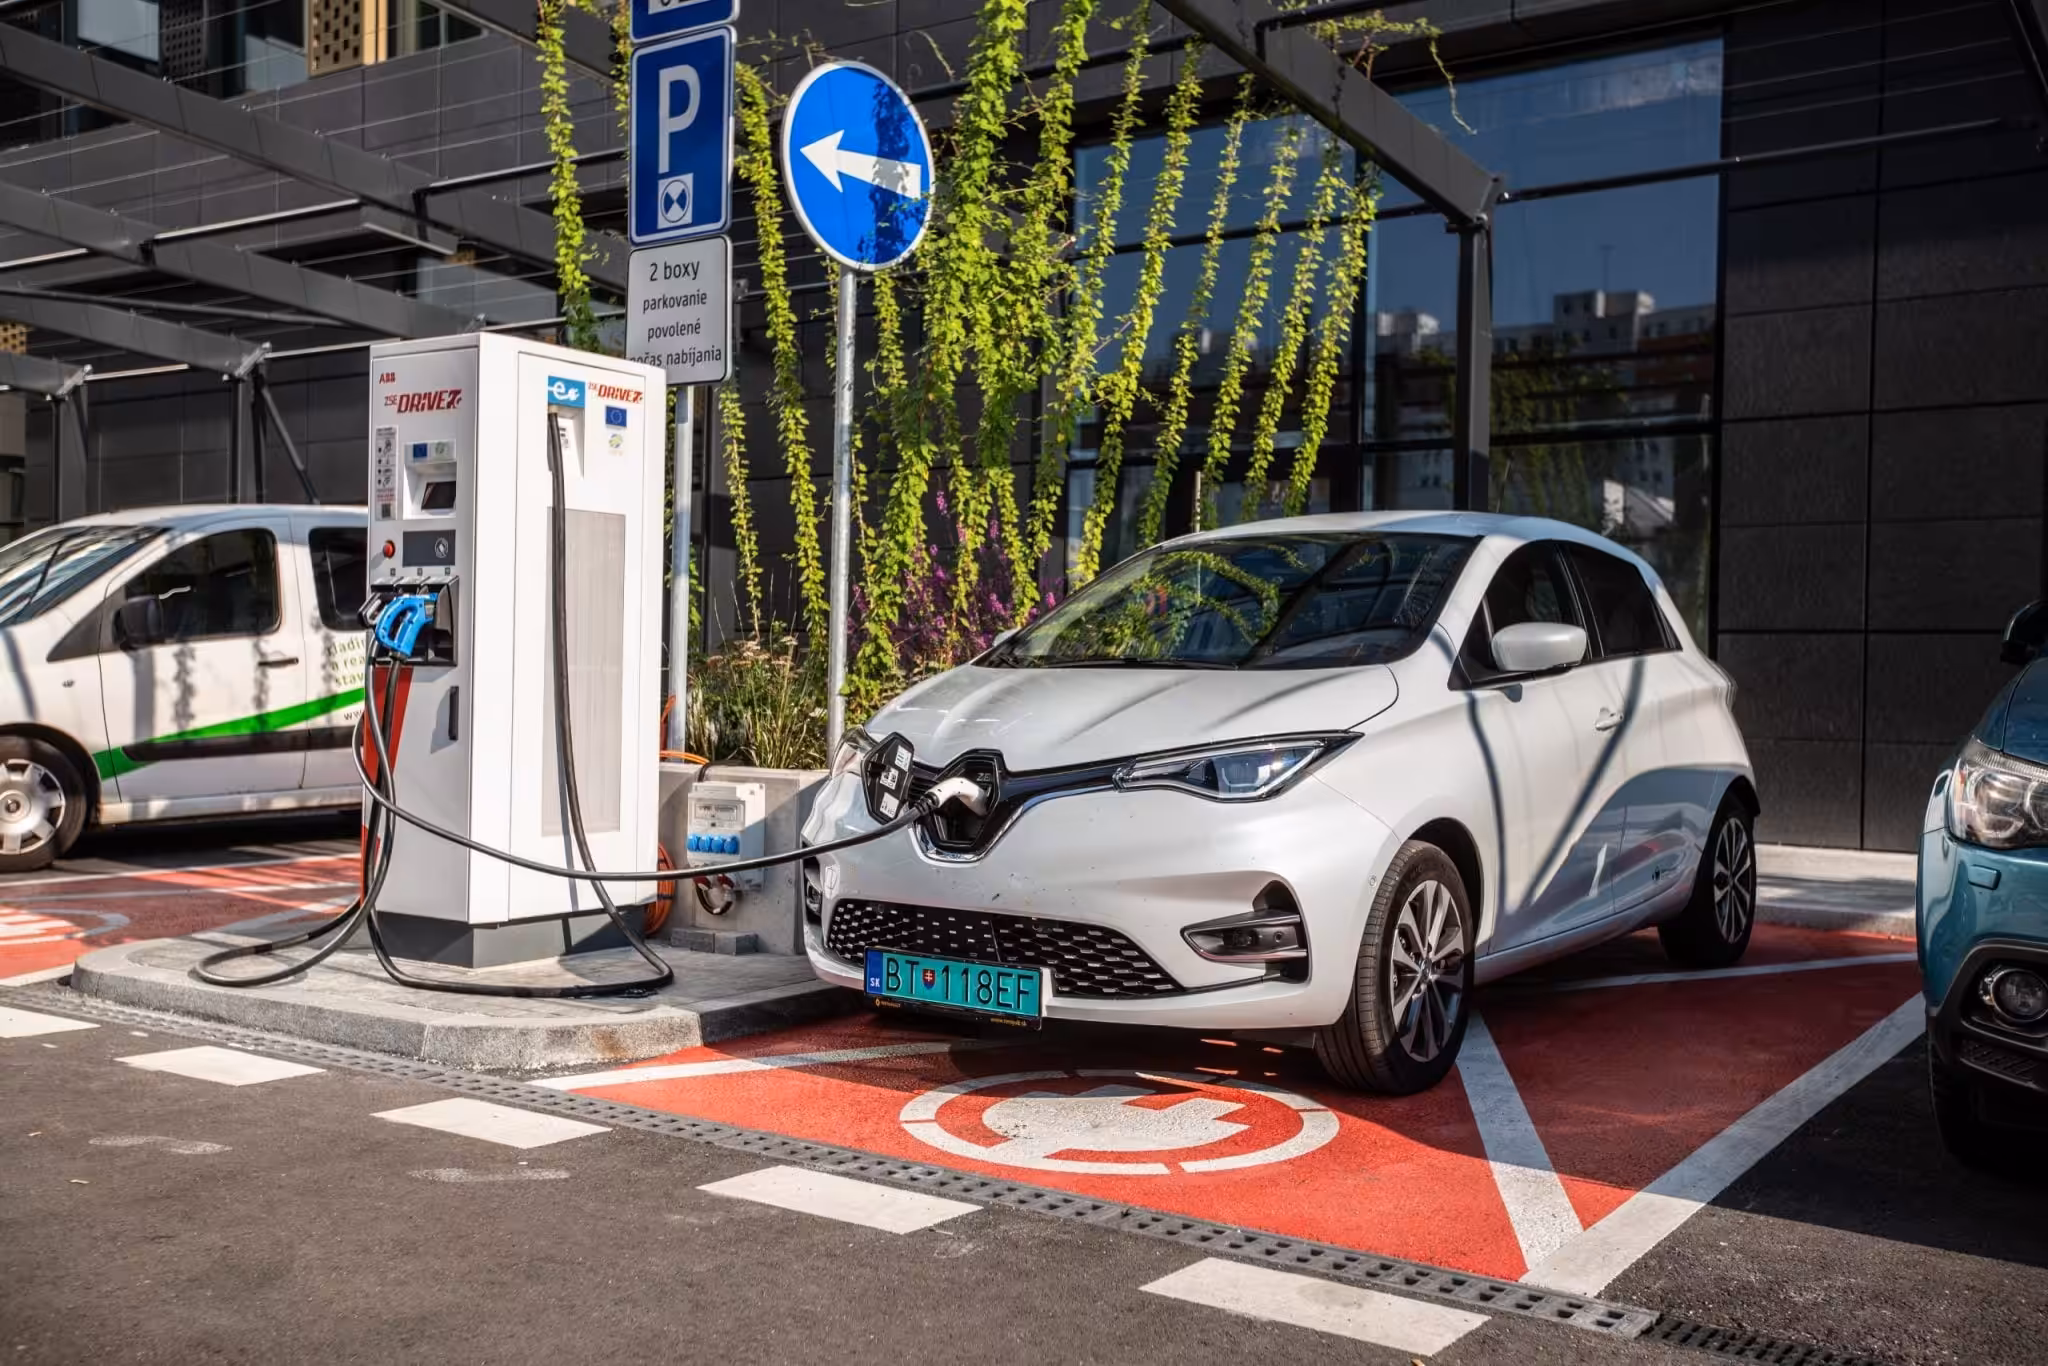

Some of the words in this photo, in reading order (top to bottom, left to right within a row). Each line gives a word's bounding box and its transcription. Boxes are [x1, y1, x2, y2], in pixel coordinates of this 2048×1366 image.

[658, 64, 701, 174] P
[649, 262, 658, 282] 2
[664, 260, 700, 281] boxy
[643, 288, 707, 314] parkovanie
[647, 318, 701, 343] povolené
[630, 351, 662, 367] čas
[666, 345, 721, 367] nabíjania
[869, 977, 881, 988] SK
[886, 957, 920, 995] BT
[941, 964, 1034, 1010] 118EF
